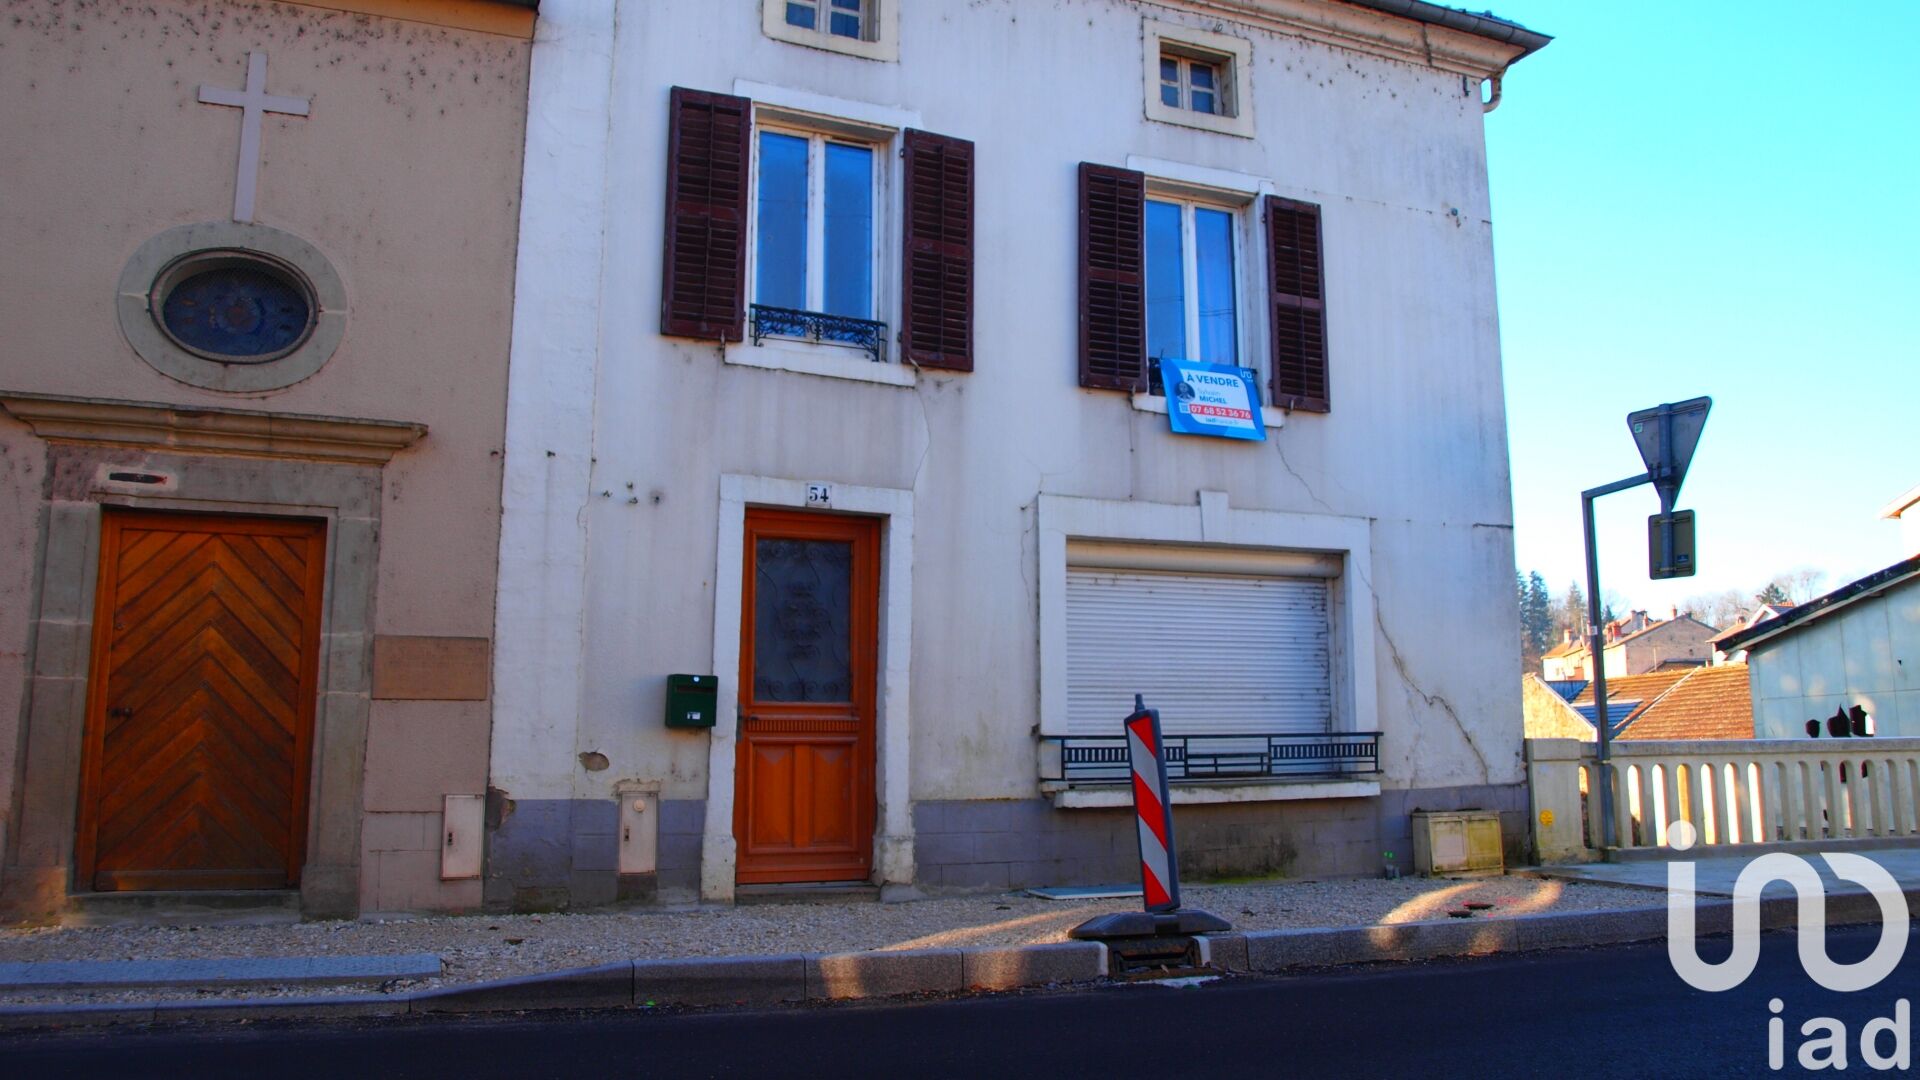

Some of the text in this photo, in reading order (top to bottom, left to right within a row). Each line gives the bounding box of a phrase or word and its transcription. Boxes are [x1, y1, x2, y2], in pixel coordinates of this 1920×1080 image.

[1187, 371, 1195, 383] À
[1195, 374, 1239, 388] VENDRE
[1199, 395, 1227, 404] MICHEL
[1191, 405, 1202, 413] 07
[1215, 407, 1227, 416] 52
[809, 486, 829, 503] 54
